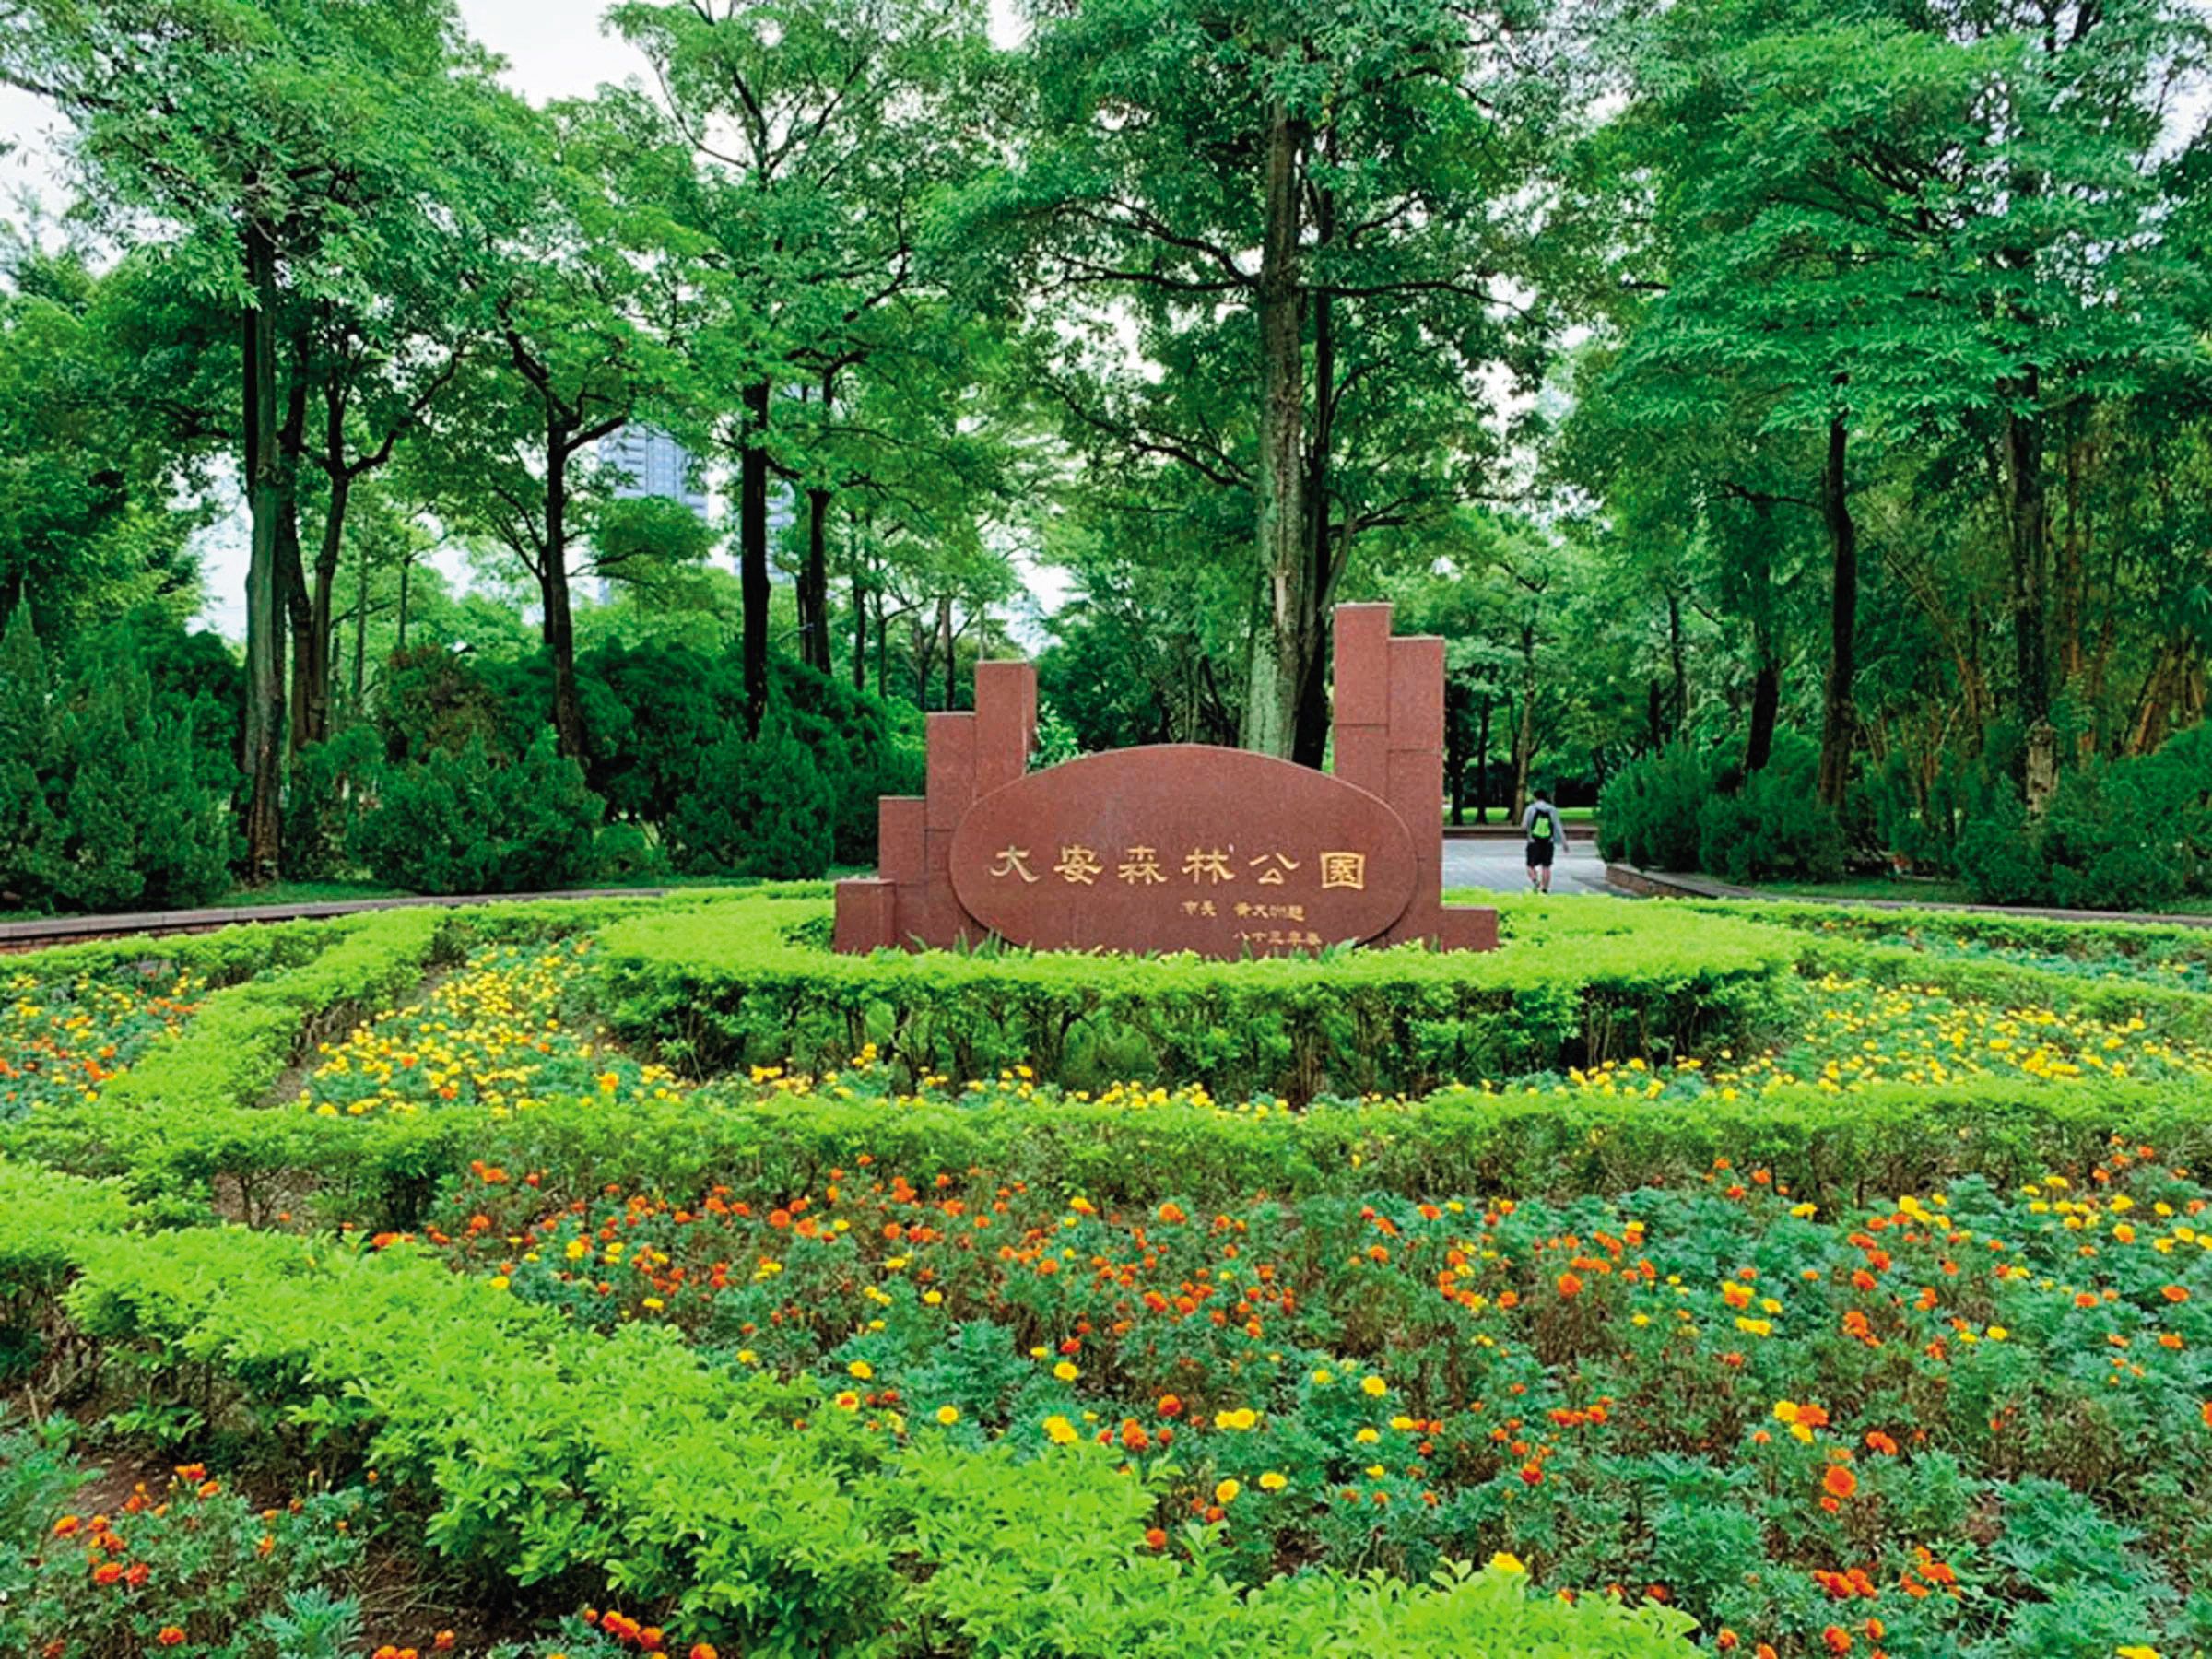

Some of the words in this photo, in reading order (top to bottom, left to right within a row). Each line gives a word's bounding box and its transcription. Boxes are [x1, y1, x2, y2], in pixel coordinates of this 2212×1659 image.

[989, 843, 1366, 891] 大安森林公園
